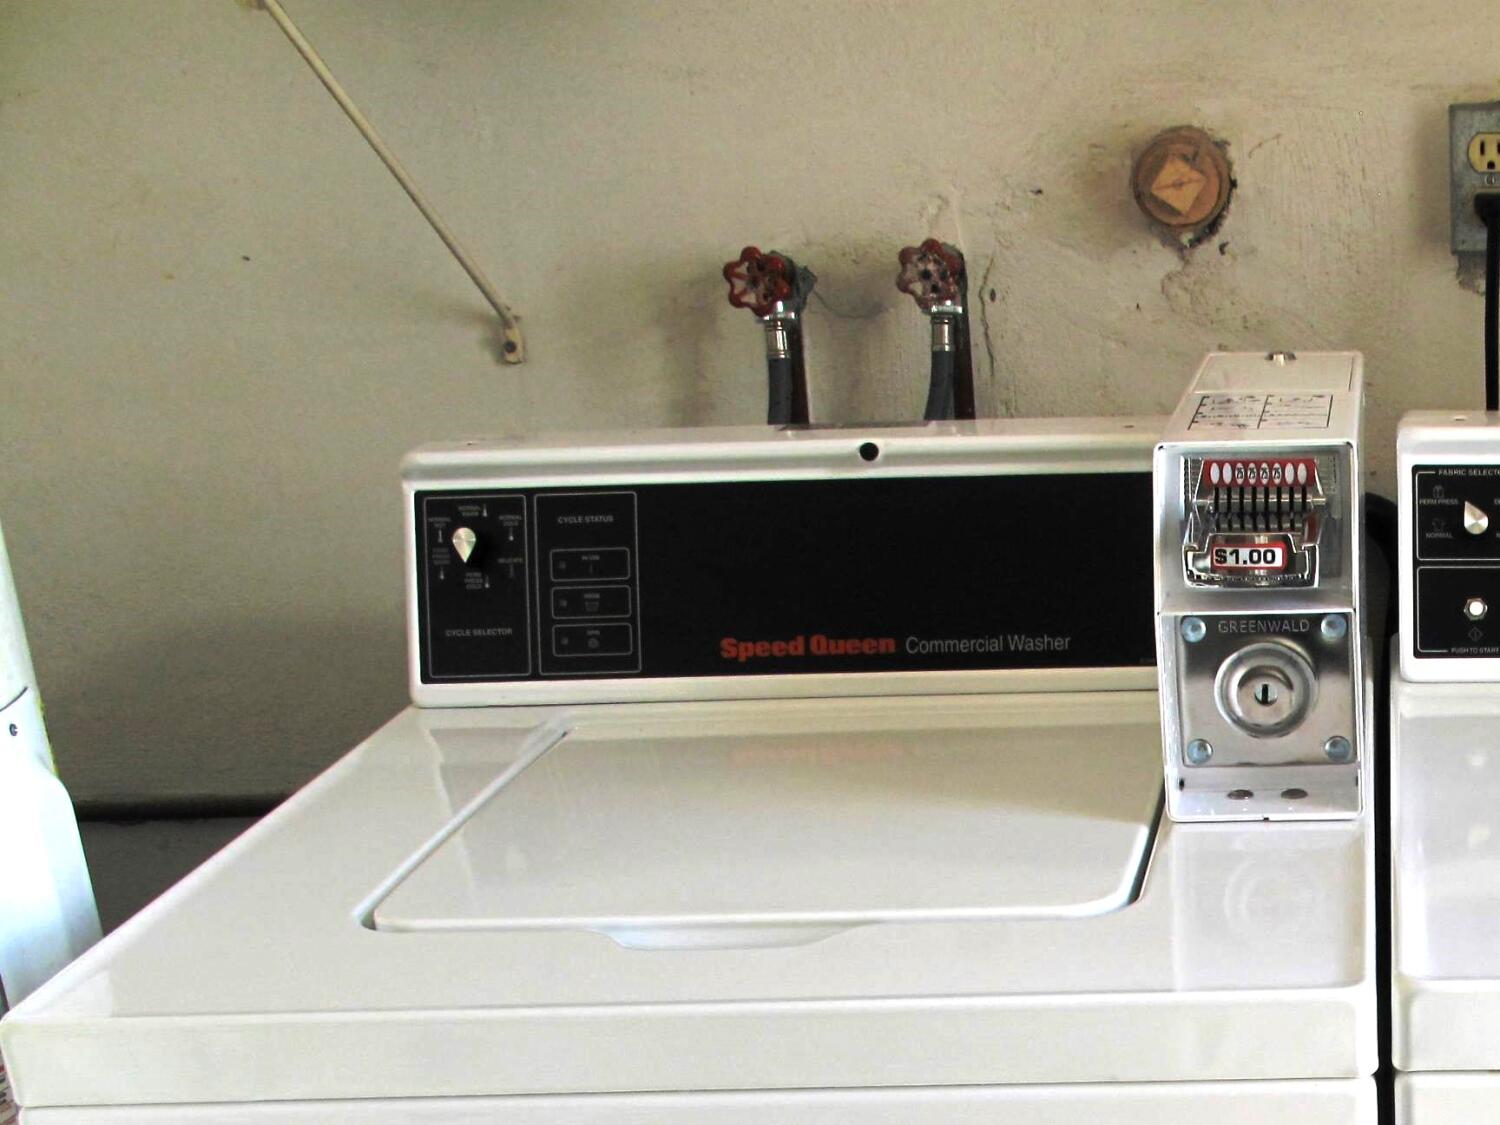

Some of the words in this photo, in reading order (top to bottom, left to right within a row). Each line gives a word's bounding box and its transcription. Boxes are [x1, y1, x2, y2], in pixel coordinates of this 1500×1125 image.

[1438, 468, 1467, 476] FABRIC
[558, 515, 583, 524] CYCLE
[584, 514, 614, 523] STATUS
[1214, 548, 1276, 565] $1.00
[445, 628, 471, 637] CYCLE
[472, 627, 512, 636] SELECTOR
[1218, 619, 1310, 633] GREENWALD
[721, 636, 805, 662] Speed
[810, 634, 895, 656] Queen
[905, 635, 1003, 654] Commercial
[1007, 634, 1071, 652] Washer
